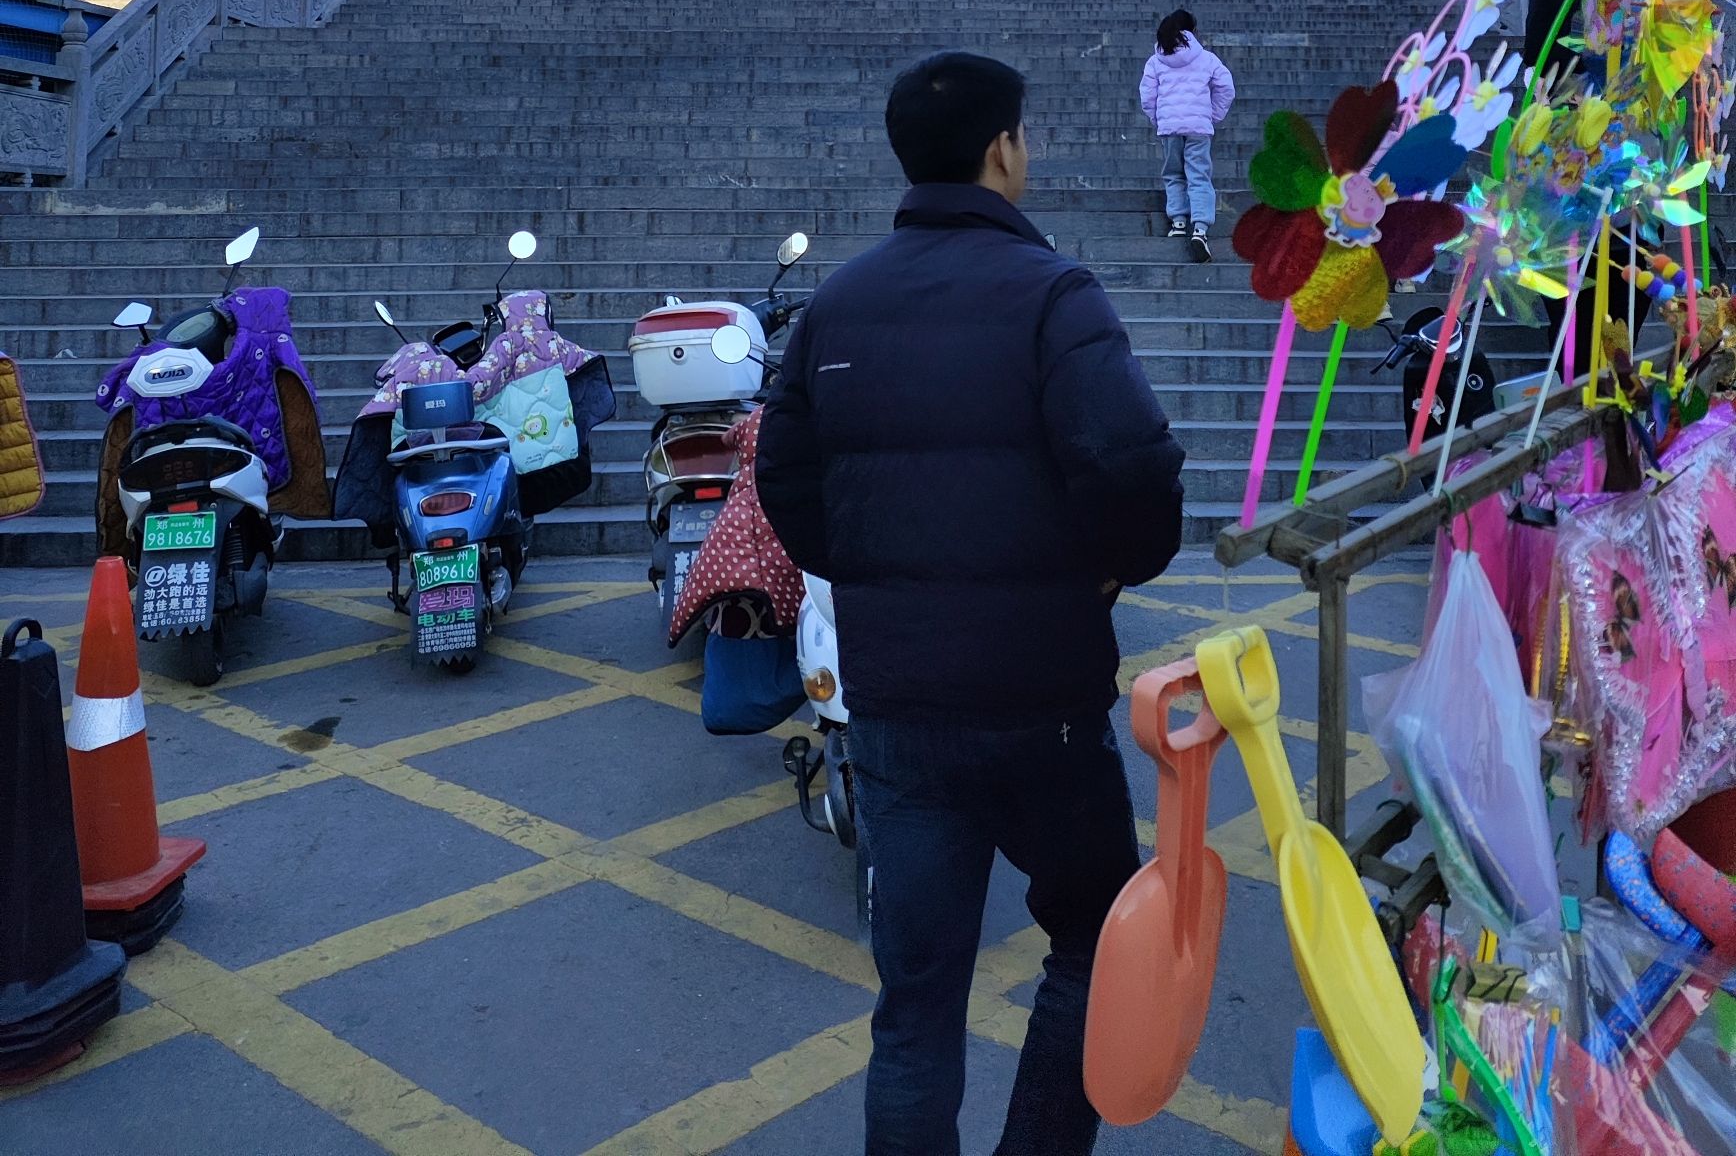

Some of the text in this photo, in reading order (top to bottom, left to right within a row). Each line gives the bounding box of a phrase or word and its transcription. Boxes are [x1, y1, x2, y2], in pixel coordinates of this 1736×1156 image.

[148, 530, 211, 546] 9818676
[167, 561, 210, 585] 绿佳
[420, 563, 474, 586] 8089616
[144, 584, 208, 600] 劲大跑的远
[419, 586, 474, 614] 爱玛
[142, 596, 207, 613] 绿佳是首选
[418, 609, 475, 626] 电动车
